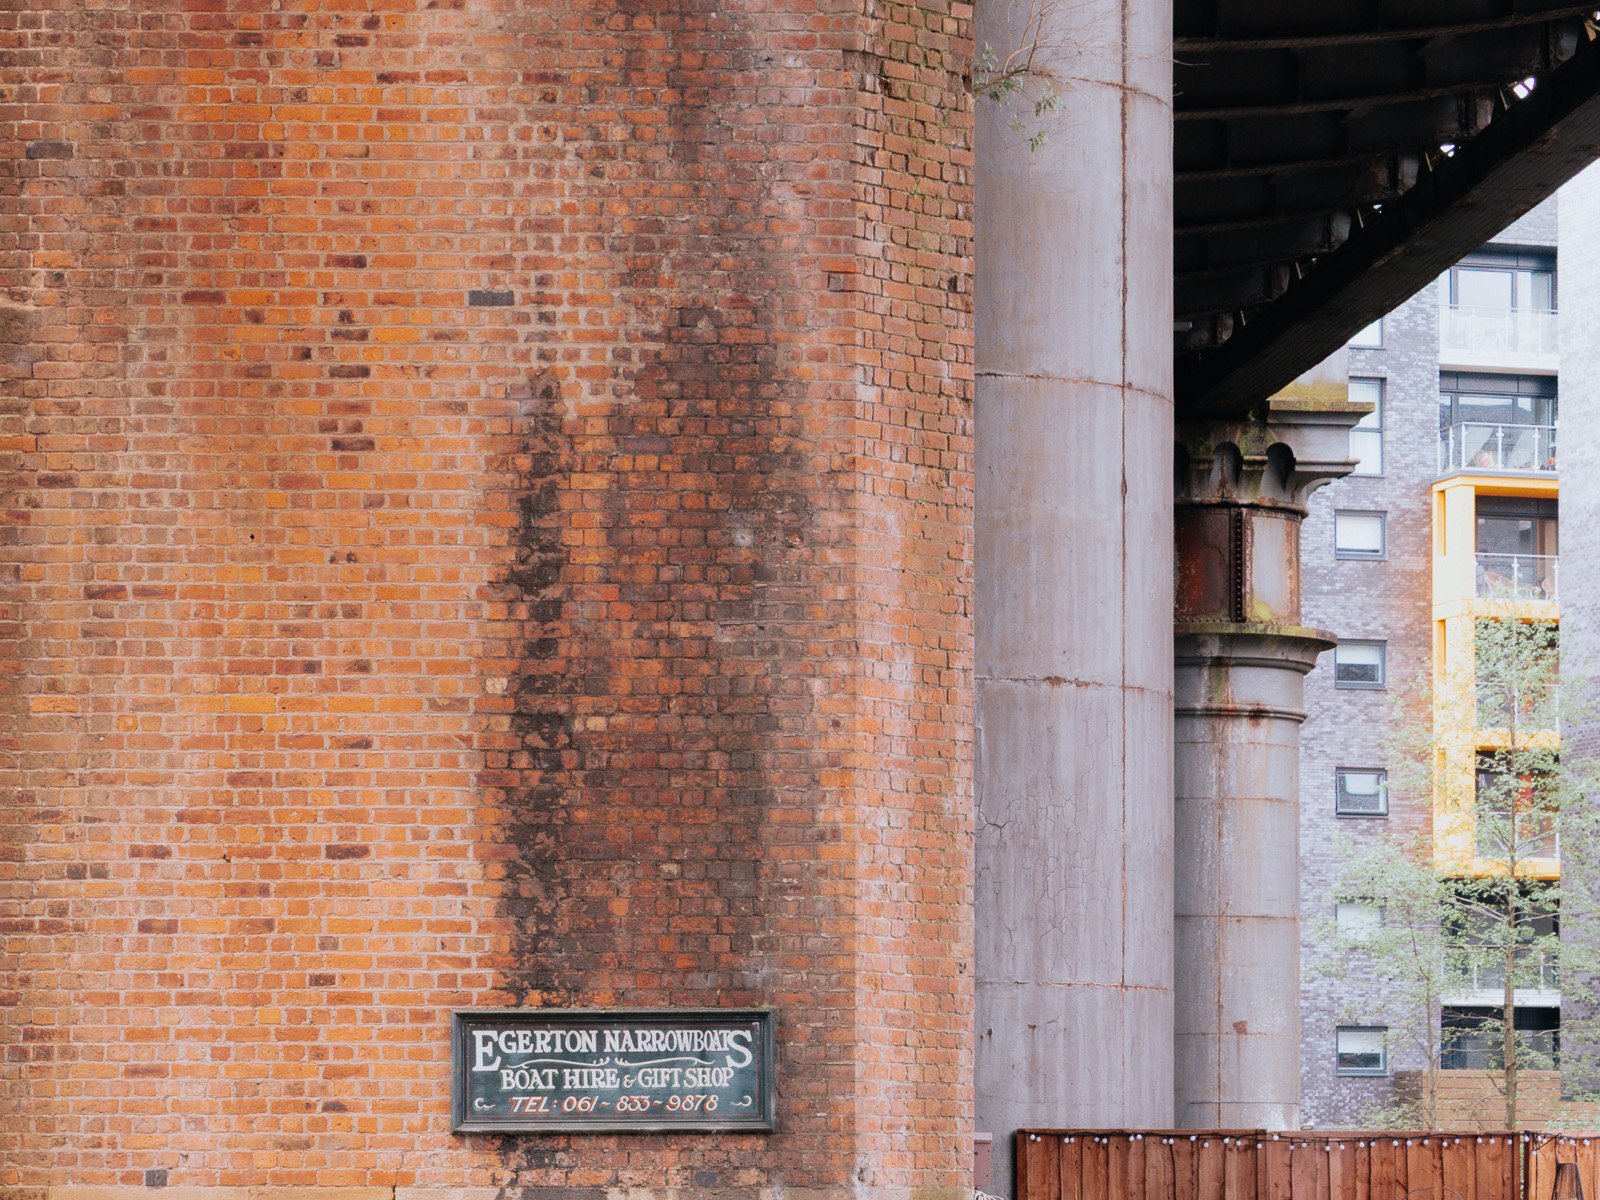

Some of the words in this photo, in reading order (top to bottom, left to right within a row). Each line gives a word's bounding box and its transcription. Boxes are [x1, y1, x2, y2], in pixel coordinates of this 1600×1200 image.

[472, 1030, 598, 1071] EGERTON
[603, 1030, 752, 1068] NARROWBOATS
[500, 1068, 559, 1090] BOAT
[563, 1068, 620, 1090] HIRE
[623, 1074, 636, 1088] &
[637, 1067, 682, 1088] GIFT
[683, 1067, 734, 1088] SHOP
[511, 1096, 558, 1113] TEL:
